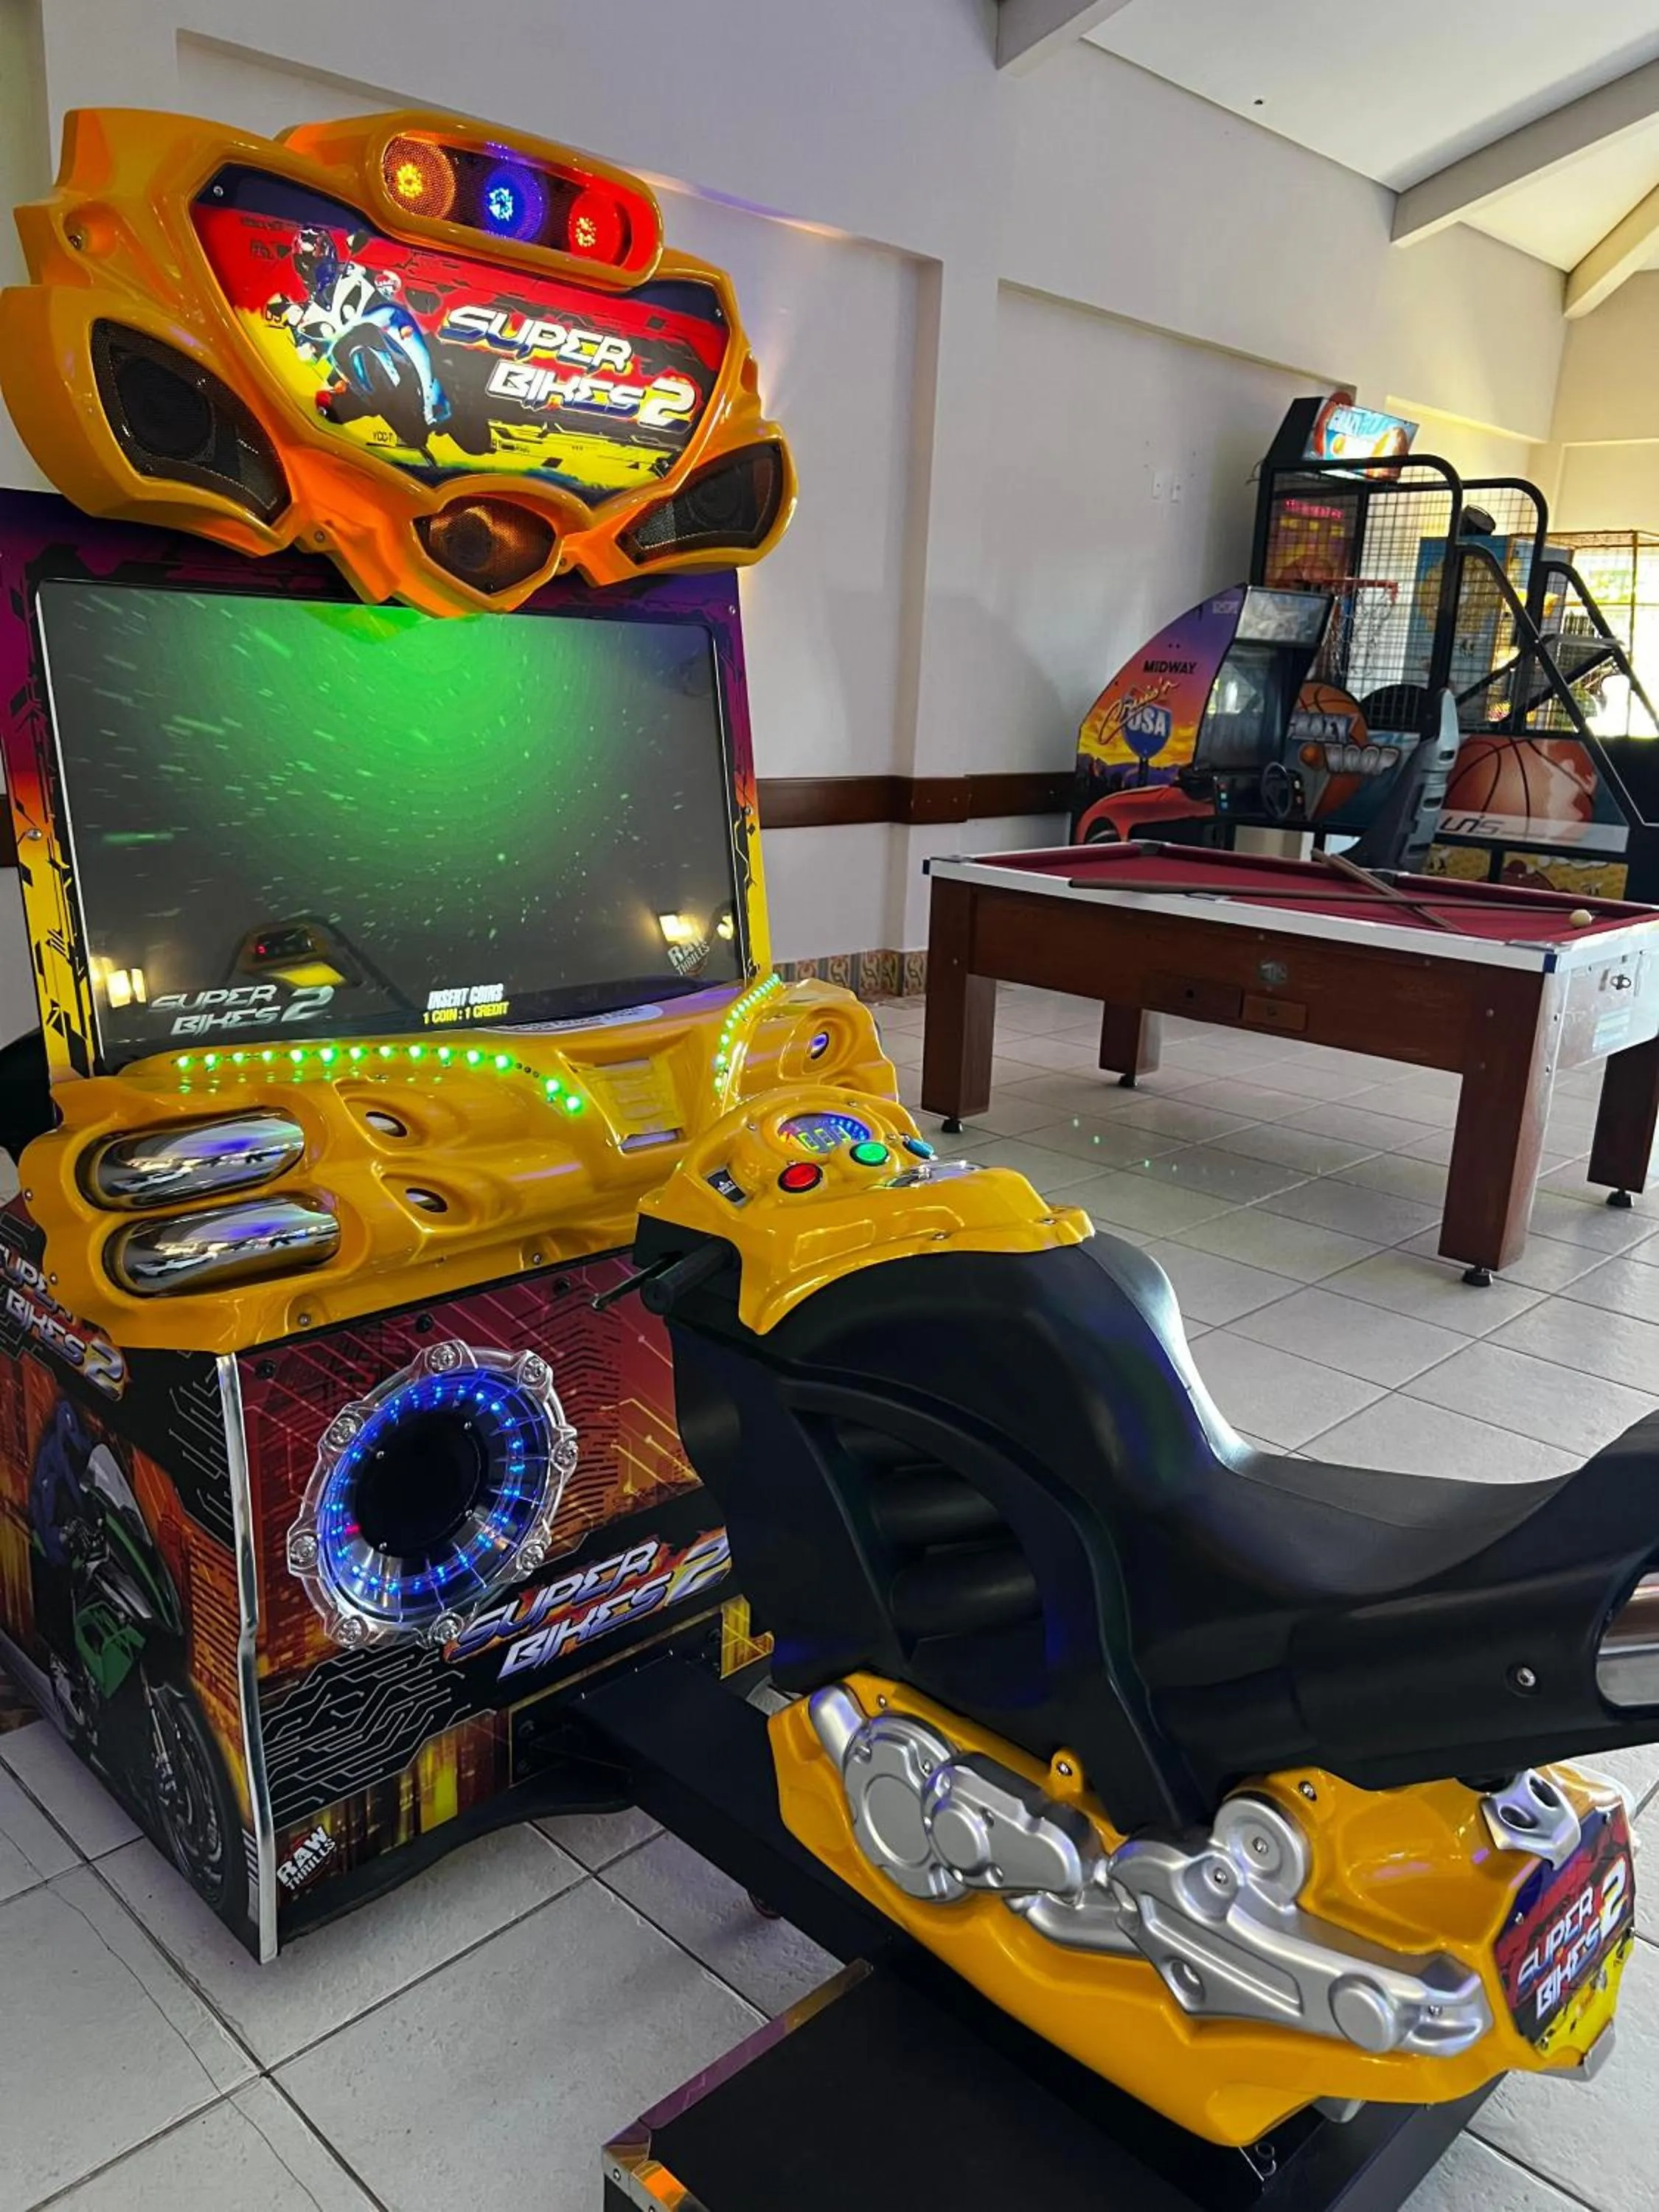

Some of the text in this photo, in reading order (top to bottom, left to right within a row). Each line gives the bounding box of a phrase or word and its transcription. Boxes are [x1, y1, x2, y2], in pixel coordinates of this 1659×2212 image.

[440, 304, 634, 373] SUPER
[486, 359, 696, 432] BIKES 2
[1143, 659, 1197, 675] MIDWAY
[1126, 707, 1167, 737] USA
[1324, 742, 1401, 776] HOOP
[147, 984, 278, 1013] SUPER
[170, 985, 335, 1037] BIKES 2
[422, 1012, 430, 1025] 1
[431, 1008, 458, 1025] COIN
[465, 1006, 471, 1020] 1
[473, 1001, 509, 1018] CREDIT
[427, 983, 504, 1010] INSERT COINS
[6, 1288, 124, 1402] BIKES 2
[448, 1540, 659, 1662] SUPER
[495, 1532, 732, 1683] BIKES 2
[276, 1826, 327, 1885] RAW
[285, 1838, 336, 1891] THRILLS
[1517, 1885, 1594, 1992] SUPER
[1537, 1857, 1627, 2020] BIKES 2
